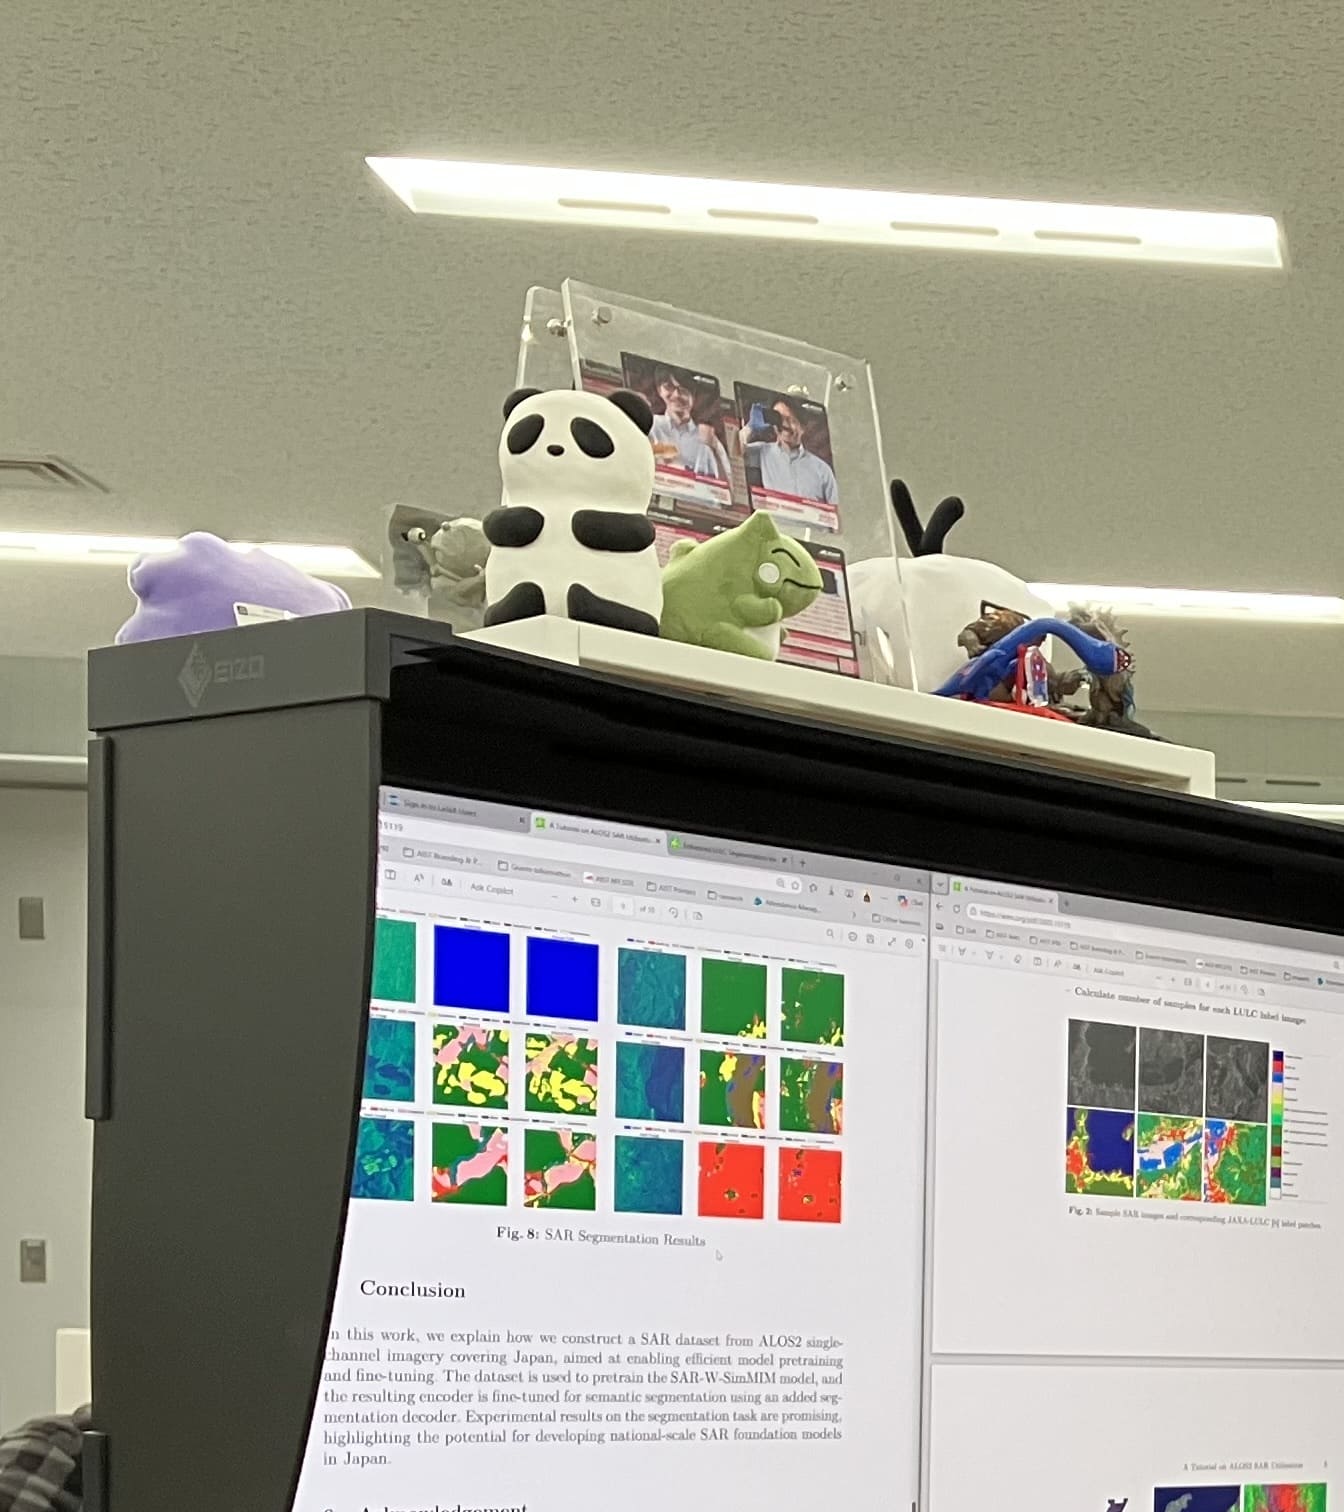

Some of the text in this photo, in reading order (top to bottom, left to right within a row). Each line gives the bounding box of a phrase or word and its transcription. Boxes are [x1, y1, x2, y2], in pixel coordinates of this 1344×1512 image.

[1074, 986, 1115, 1001] Calculate
[1153, 996, 1162, 1006] of
[1199, 1003, 1211, 1012] for
[1233, 1007, 1258, 1018] LULC
[497, 1225, 706, 1247] Fig. 8: SAR Segmentation Results
[360, 1279, 466, 1298] Conclusion
[347, 1327, 373, 1341] this
[381, 1327, 420, 1344] work,
[427, 1332, 444, 1342] we
[450, 1329, 500, 1346] explain
[507, 1329, 532, 1343] how
[540, 1334, 556, 1343] we
[562, 1333, 622, 1344] construct
[628, 1335, 635, 1344] a
[641, 1332, 670, 1345] SAR
[676, 1332, 719, 1346] dataset
[726, 1333, 753, 1346] from
[759, 1334, 802, 1347] ALOS2
[807, 1335, 843, 1352] single-
[388, 1349, 443, 1366] imagery
[450, 1350, 507, 1366] covering
[513, 1349, 557, 1367] Japan,
[564, 1351, 601, 1364] aimed
[608, 1352, 620, 1364] at
[627, 1351, 680, 1368] enabling
[686, 1351, 731, 1365] efficient
[738, 1352, 773, 1366] model
[779, 1354, 843, 1370] pretraining
[324, 1368, 350, 1382] and
[443, 1369, 470, 1383] The
[475, 1369, 523, 1383] dataset
[528, 1370, 537, 1383] is
[543, 1369, 571, 1383] used
[576, 1371, 588, 1383] to
[593, 1371, 643, 1387] pretrain
[648, 1370, 667, 1384] the
[670, 1370, 776, 1384] SAR-W-SimMIM
[780, 1371, 818, 1387] model,
[822, 1371, 842, 1384] and
[324, 1389, 842, 1406] the resulting encoder is fine-tuned for semantic segmentation using an added seg-
[324, 1410, 398, 1423] mentation
[402, 1409, 460, 1423] decoder.
[466, 1409, 556, 1426] Experimental
[560, 1409, 601, 1422] results
[606, 1413, 621, 1422] on
[626, 1408, 644, 1422] the
[649, 1409, 729, 1425] segmentation
[733, 1408, 757, 1422] task
[761, 1412, 778, 1422] are
[324, 1426, 841, 1447] highlighting the potential for developing national-scale SAR foundation models
[324, 1450, 391, 1468] in Japan.
